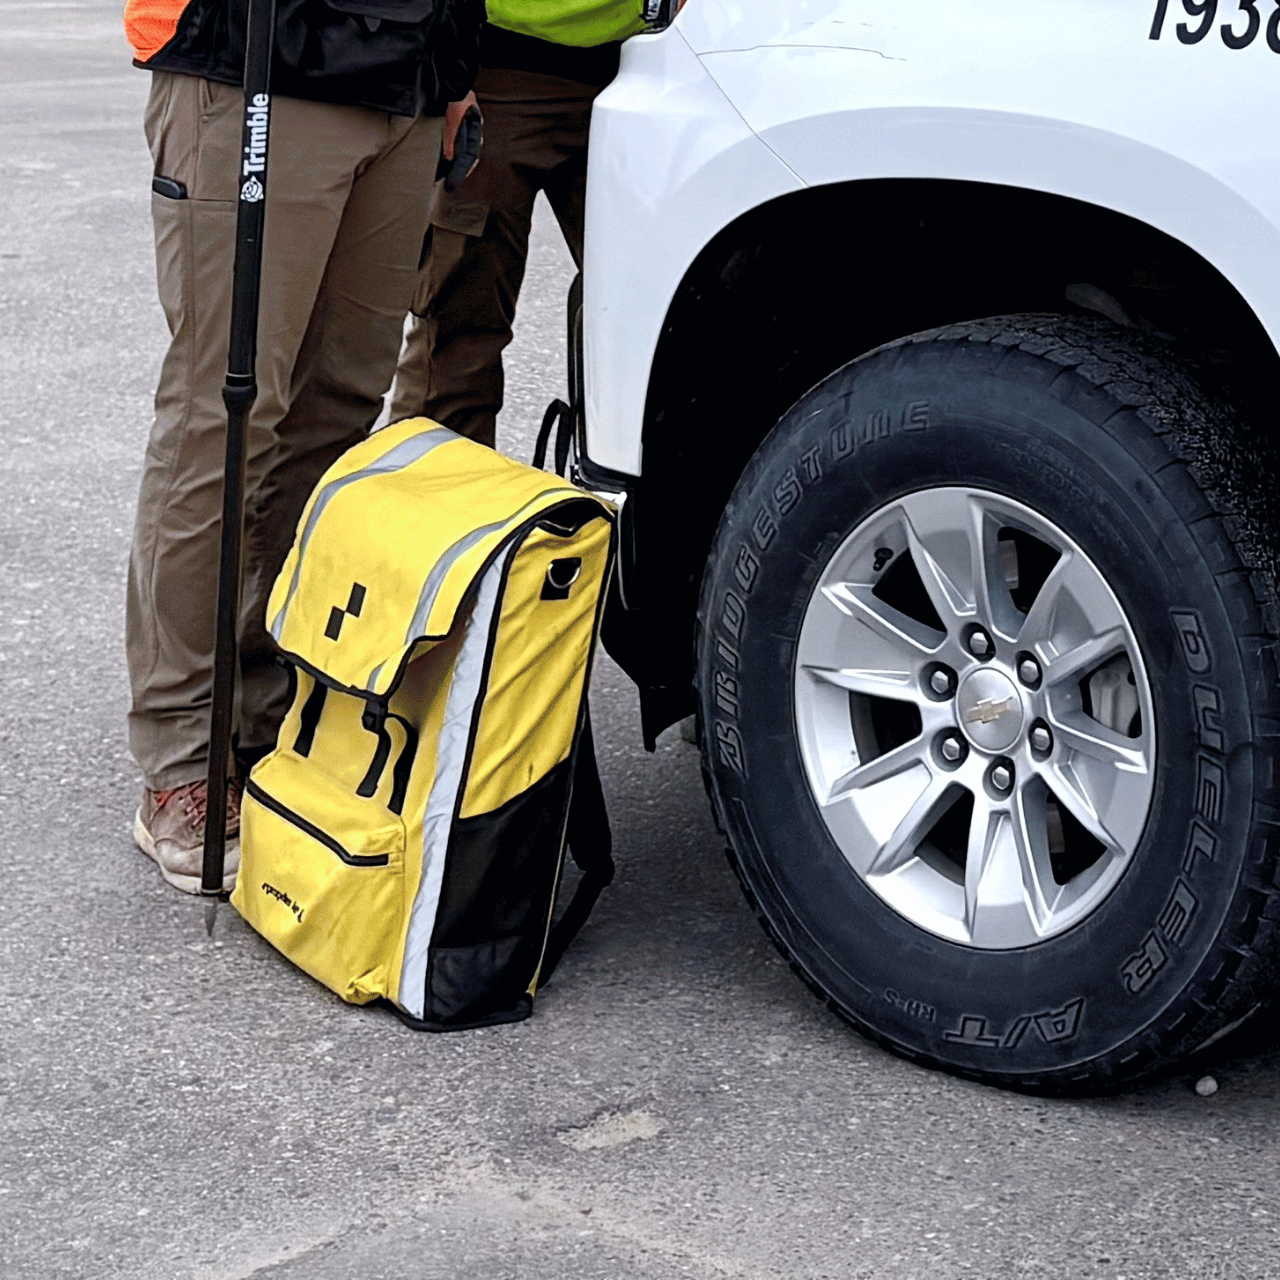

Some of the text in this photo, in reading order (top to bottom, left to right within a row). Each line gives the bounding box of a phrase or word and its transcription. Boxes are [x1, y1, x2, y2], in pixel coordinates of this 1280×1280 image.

[243, 93, 269, 176] Trimble
[1120, 608, 1225, 995] DUELER
[943, 996, 1087, 1050] A/T
